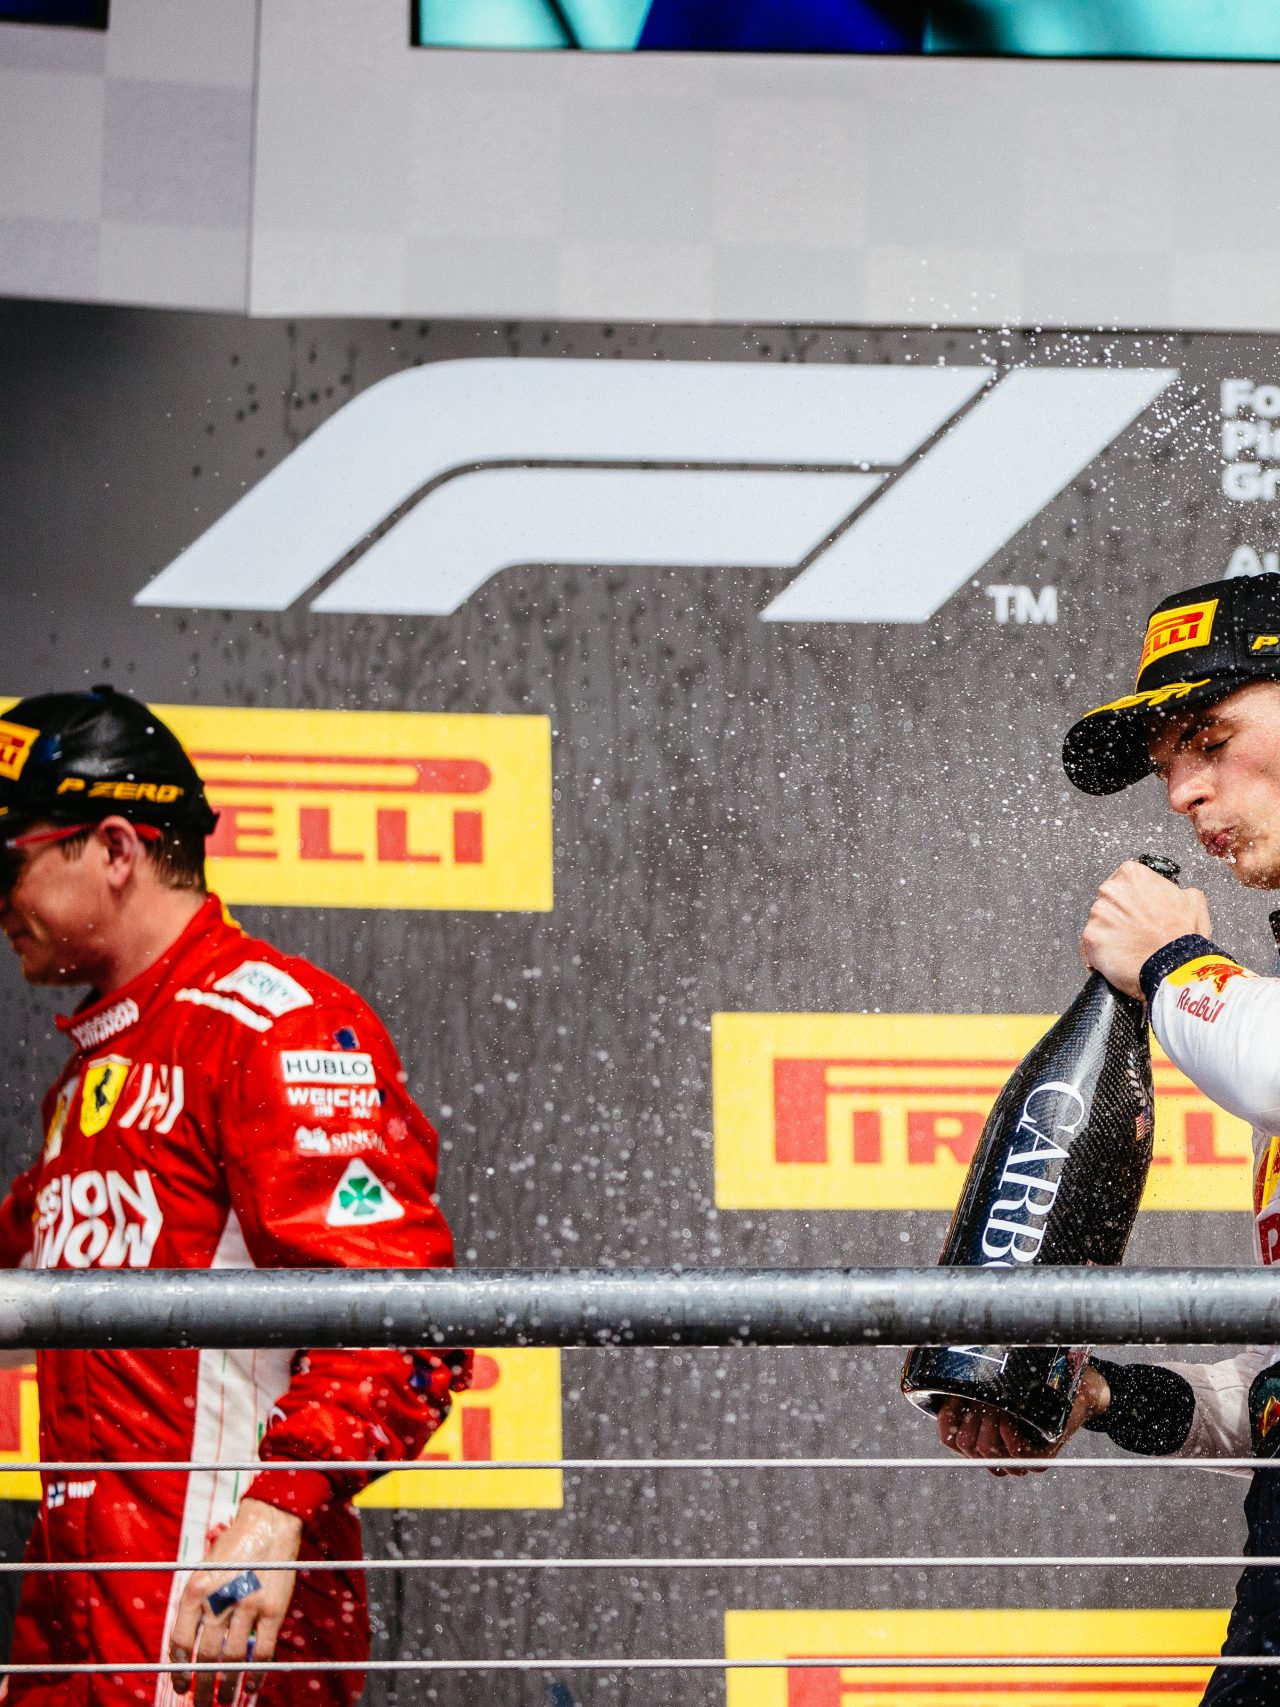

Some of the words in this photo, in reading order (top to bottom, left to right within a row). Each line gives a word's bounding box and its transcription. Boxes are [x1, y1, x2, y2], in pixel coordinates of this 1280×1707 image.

[987, 585, 1058, 625] TM
[1251, 635, 1279, 651] P
[57, 778, 86, 795] P
